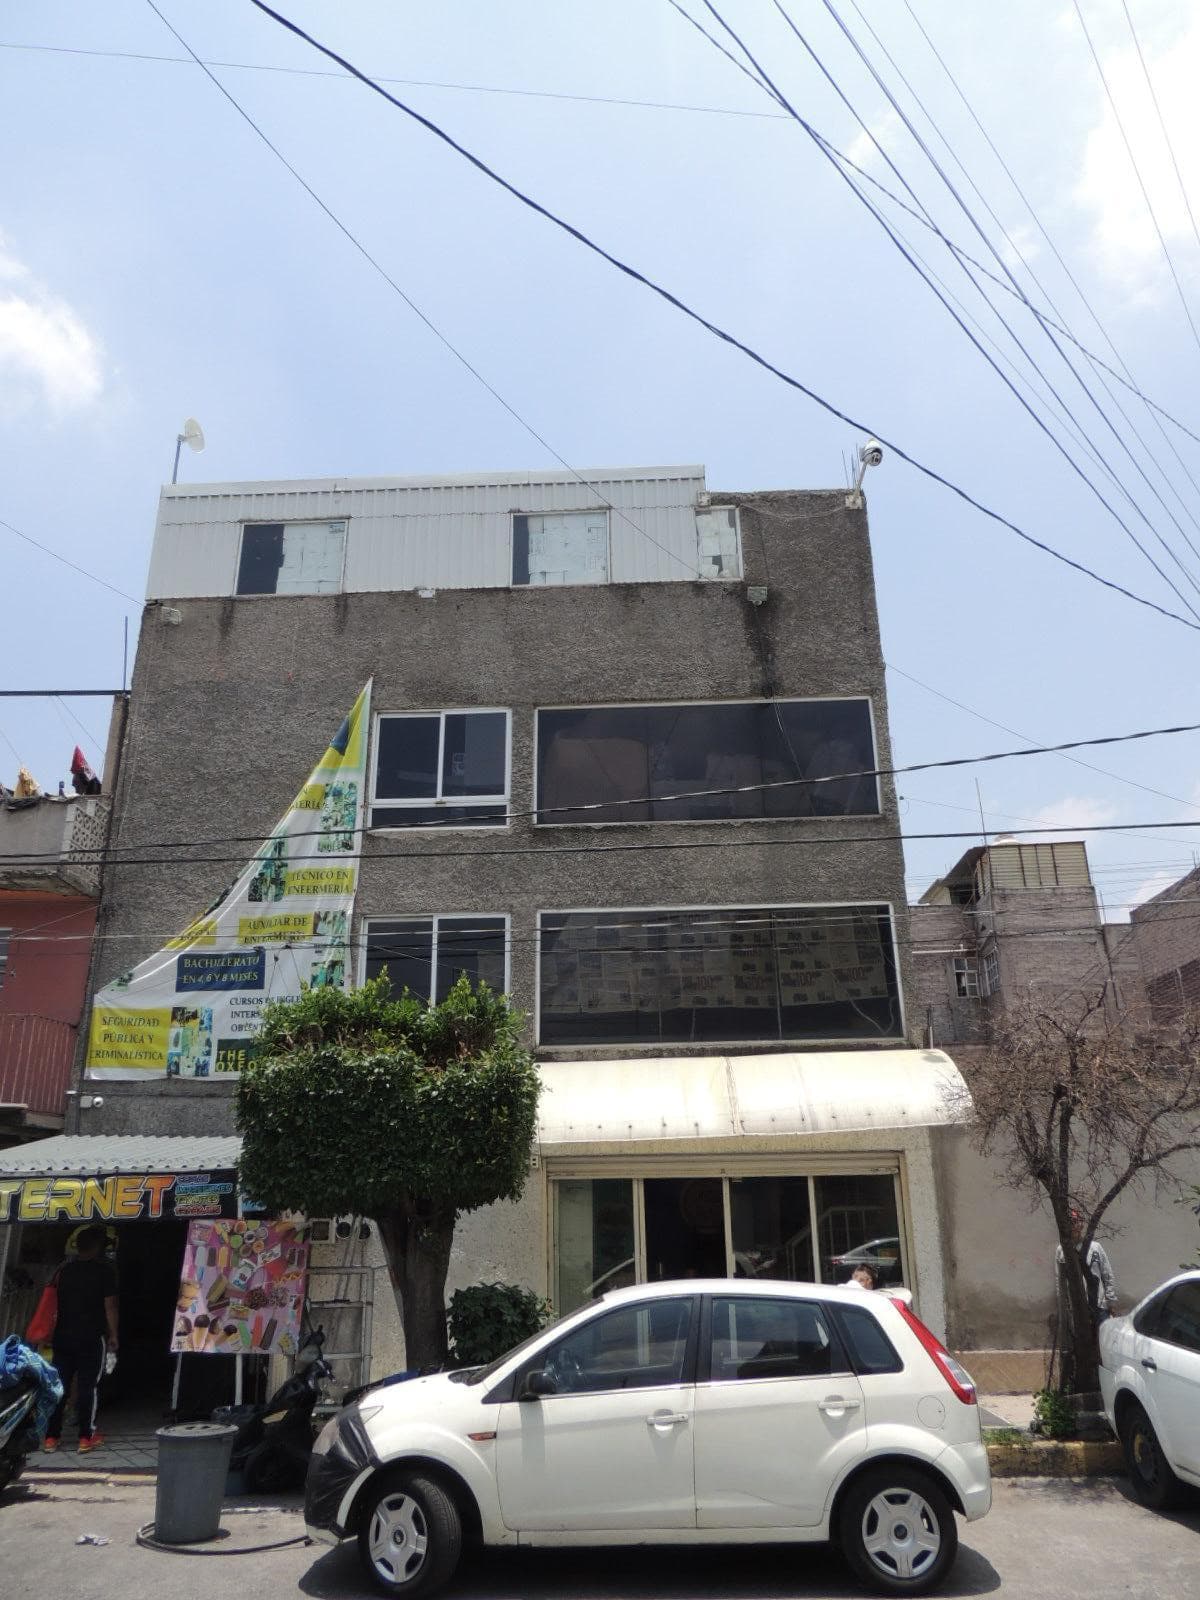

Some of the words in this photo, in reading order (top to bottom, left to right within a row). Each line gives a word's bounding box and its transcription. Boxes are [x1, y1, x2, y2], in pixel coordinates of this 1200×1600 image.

[293, 917, 308, 927] DE
[183, 956, 260, 969] BACHILLERATO
[182, 975, 197, 985] EN
[229, 997, 263, 1006] CURSOS
[101, 1016, 161, 1027] SEGURIDAD
[147, 1033, 154, 1044] Y
[219, 1049, 246, 1061] THE
[216, 1060, 258, 1073] OXFO
[0, 1175, 177, 1220] TERNET
